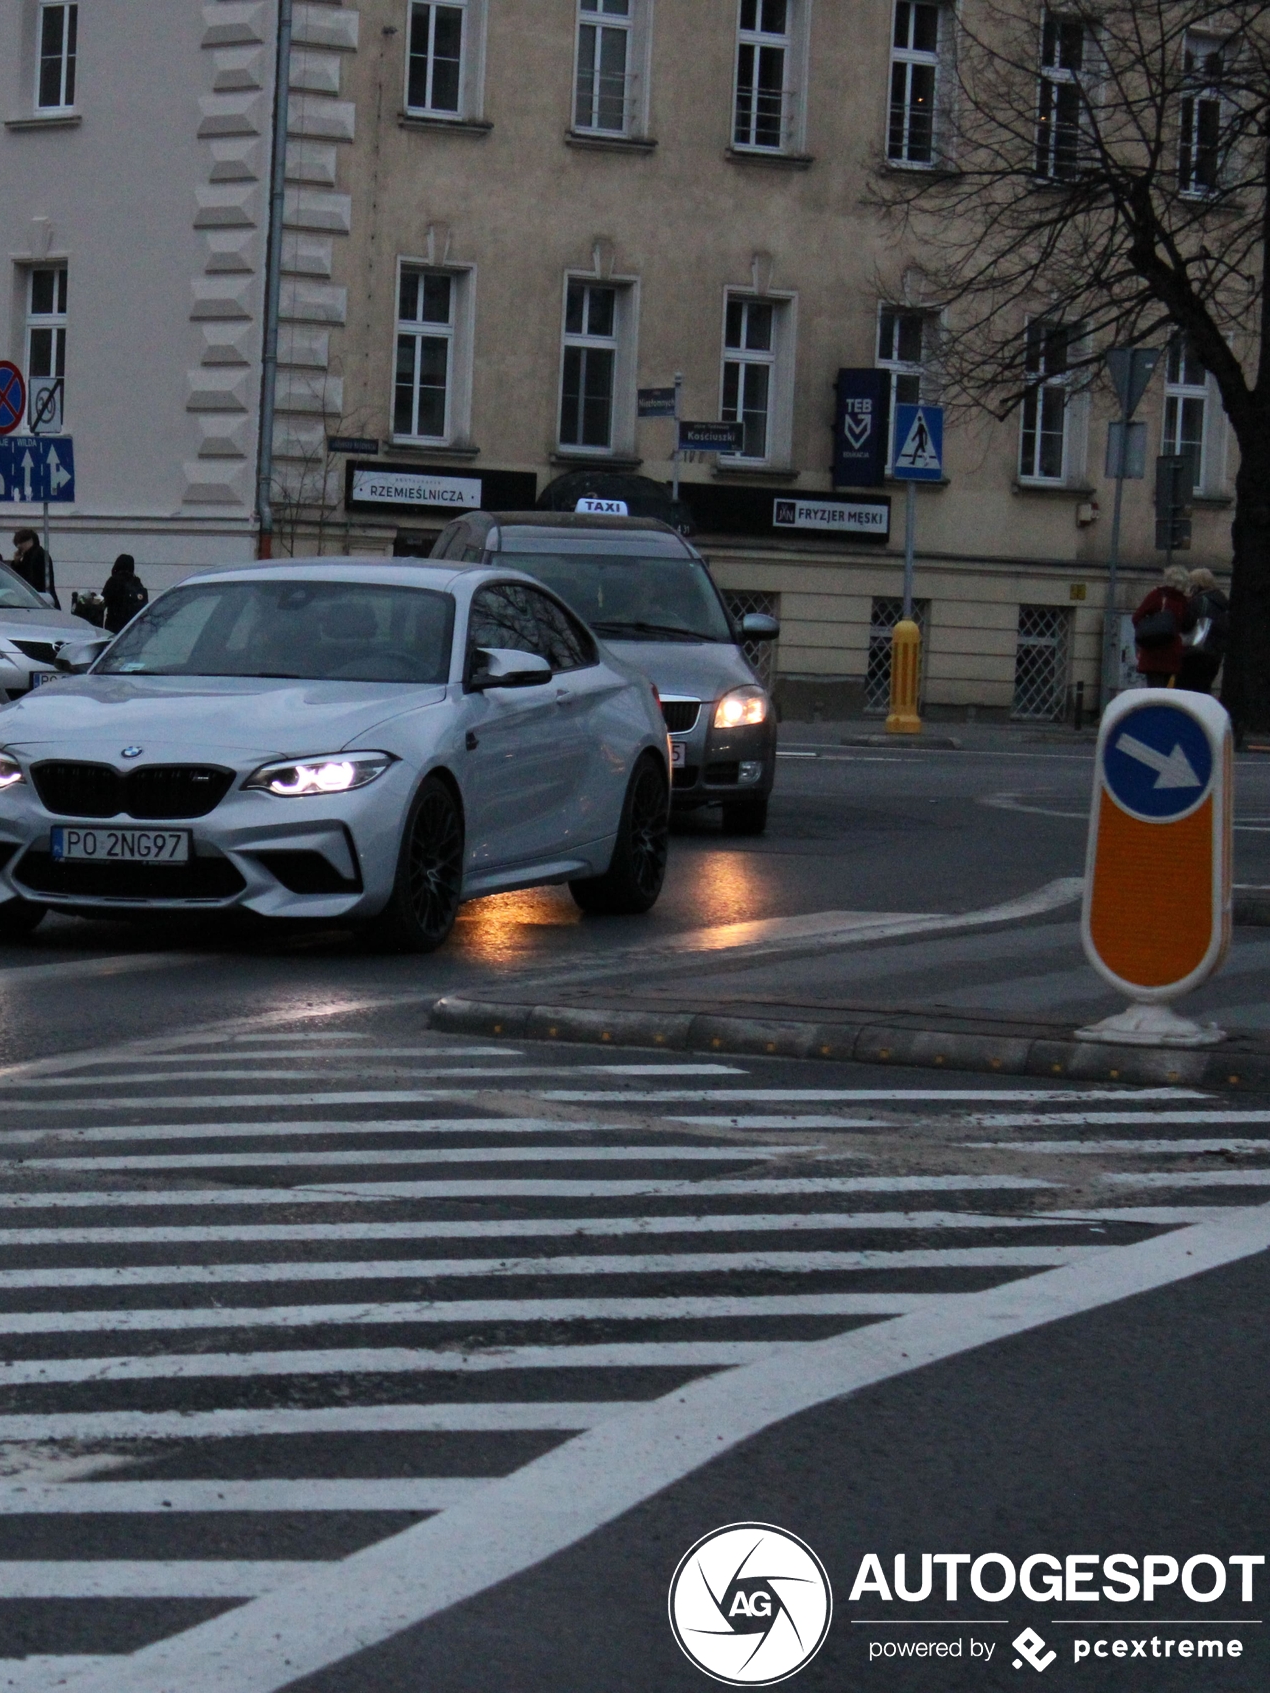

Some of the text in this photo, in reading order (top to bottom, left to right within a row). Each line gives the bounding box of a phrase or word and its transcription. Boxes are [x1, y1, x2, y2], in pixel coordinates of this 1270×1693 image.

[846, 398, 873, 413] TEB
[16, 438, 37, 447] WILDA
[687, 431, 735, 441] Kościuszki
[370, 485, 464, 502] RZEMIEŚLNICZA
[585, 501, 620, 513] TAXI
[798, 508, 883, 525] FRYZJER MĘSKI
[67, 831, 182, 858] PO 2NG97
